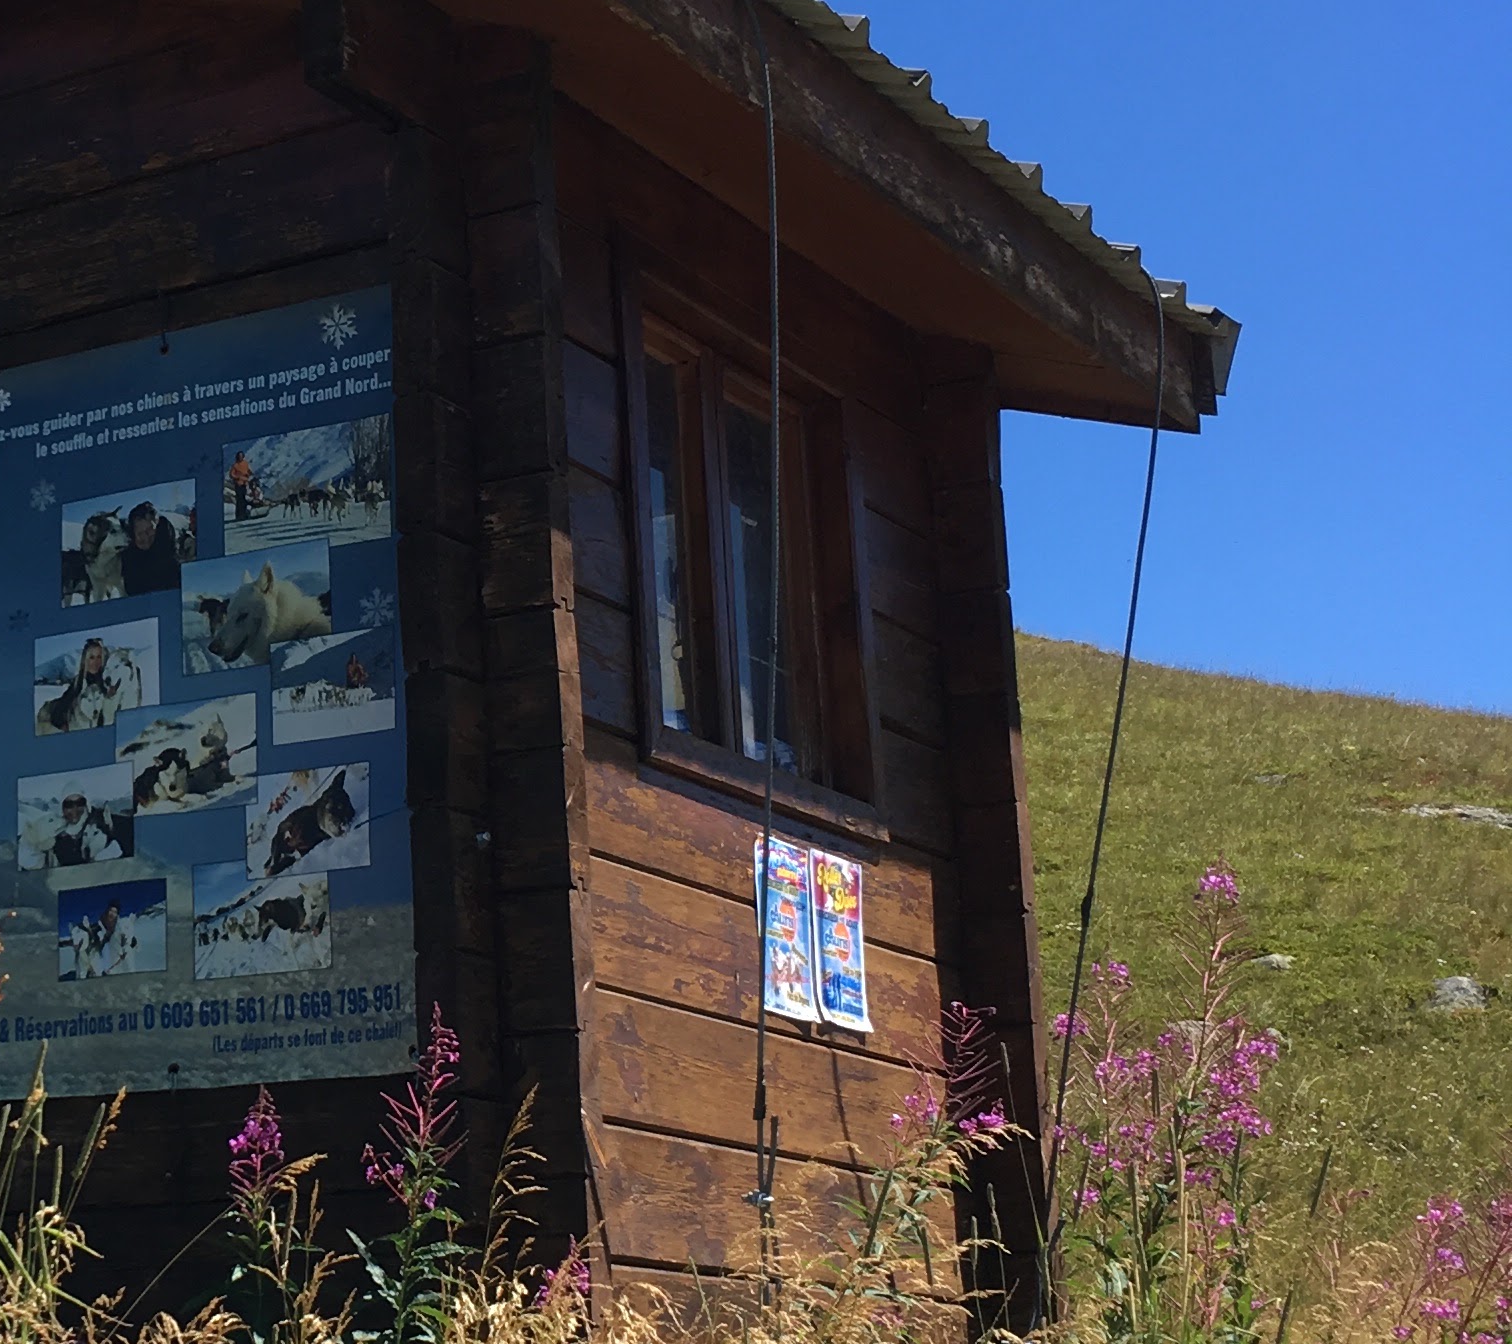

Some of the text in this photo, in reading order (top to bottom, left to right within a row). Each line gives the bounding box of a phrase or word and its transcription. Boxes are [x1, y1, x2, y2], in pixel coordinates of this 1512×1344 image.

[36, 373, 391, 458] le souffle et ressentez les sensations du Grand Nord...
[43, 411, 83, 436] guider
[87, 407, 108, 426] par
[111, 402, 134, 418] nos
[137, 389, 179, 412] chiens
[183, 386, 191, 402] à
[195, 378, 244, 400] travers
[248, 374, 265, 390] un
[269, 362, 325, 389] paysage
[330, 357, 338, 374] à
[342, 348, 391, 371] couper
[0, 1017, 10, 1043] &
[15, 1011, 114, 1042] Réservations
[119, 1012, 138, 1031] au
[143, 1004, 155, 1030] 0
[161, 1002, 194, 1029] 603
[199, 999, 229, 1027] 651
[235, 996, 265, 1024] 561
[284, 993, 295, 1021] 0
[300, 990, 331, 1019] 669
[337, 987, 368, 1015] 795
[373, 982, 401, 1012] 951
[213, 1021, 402, 1055] (Les départs se font de ce chalet)
